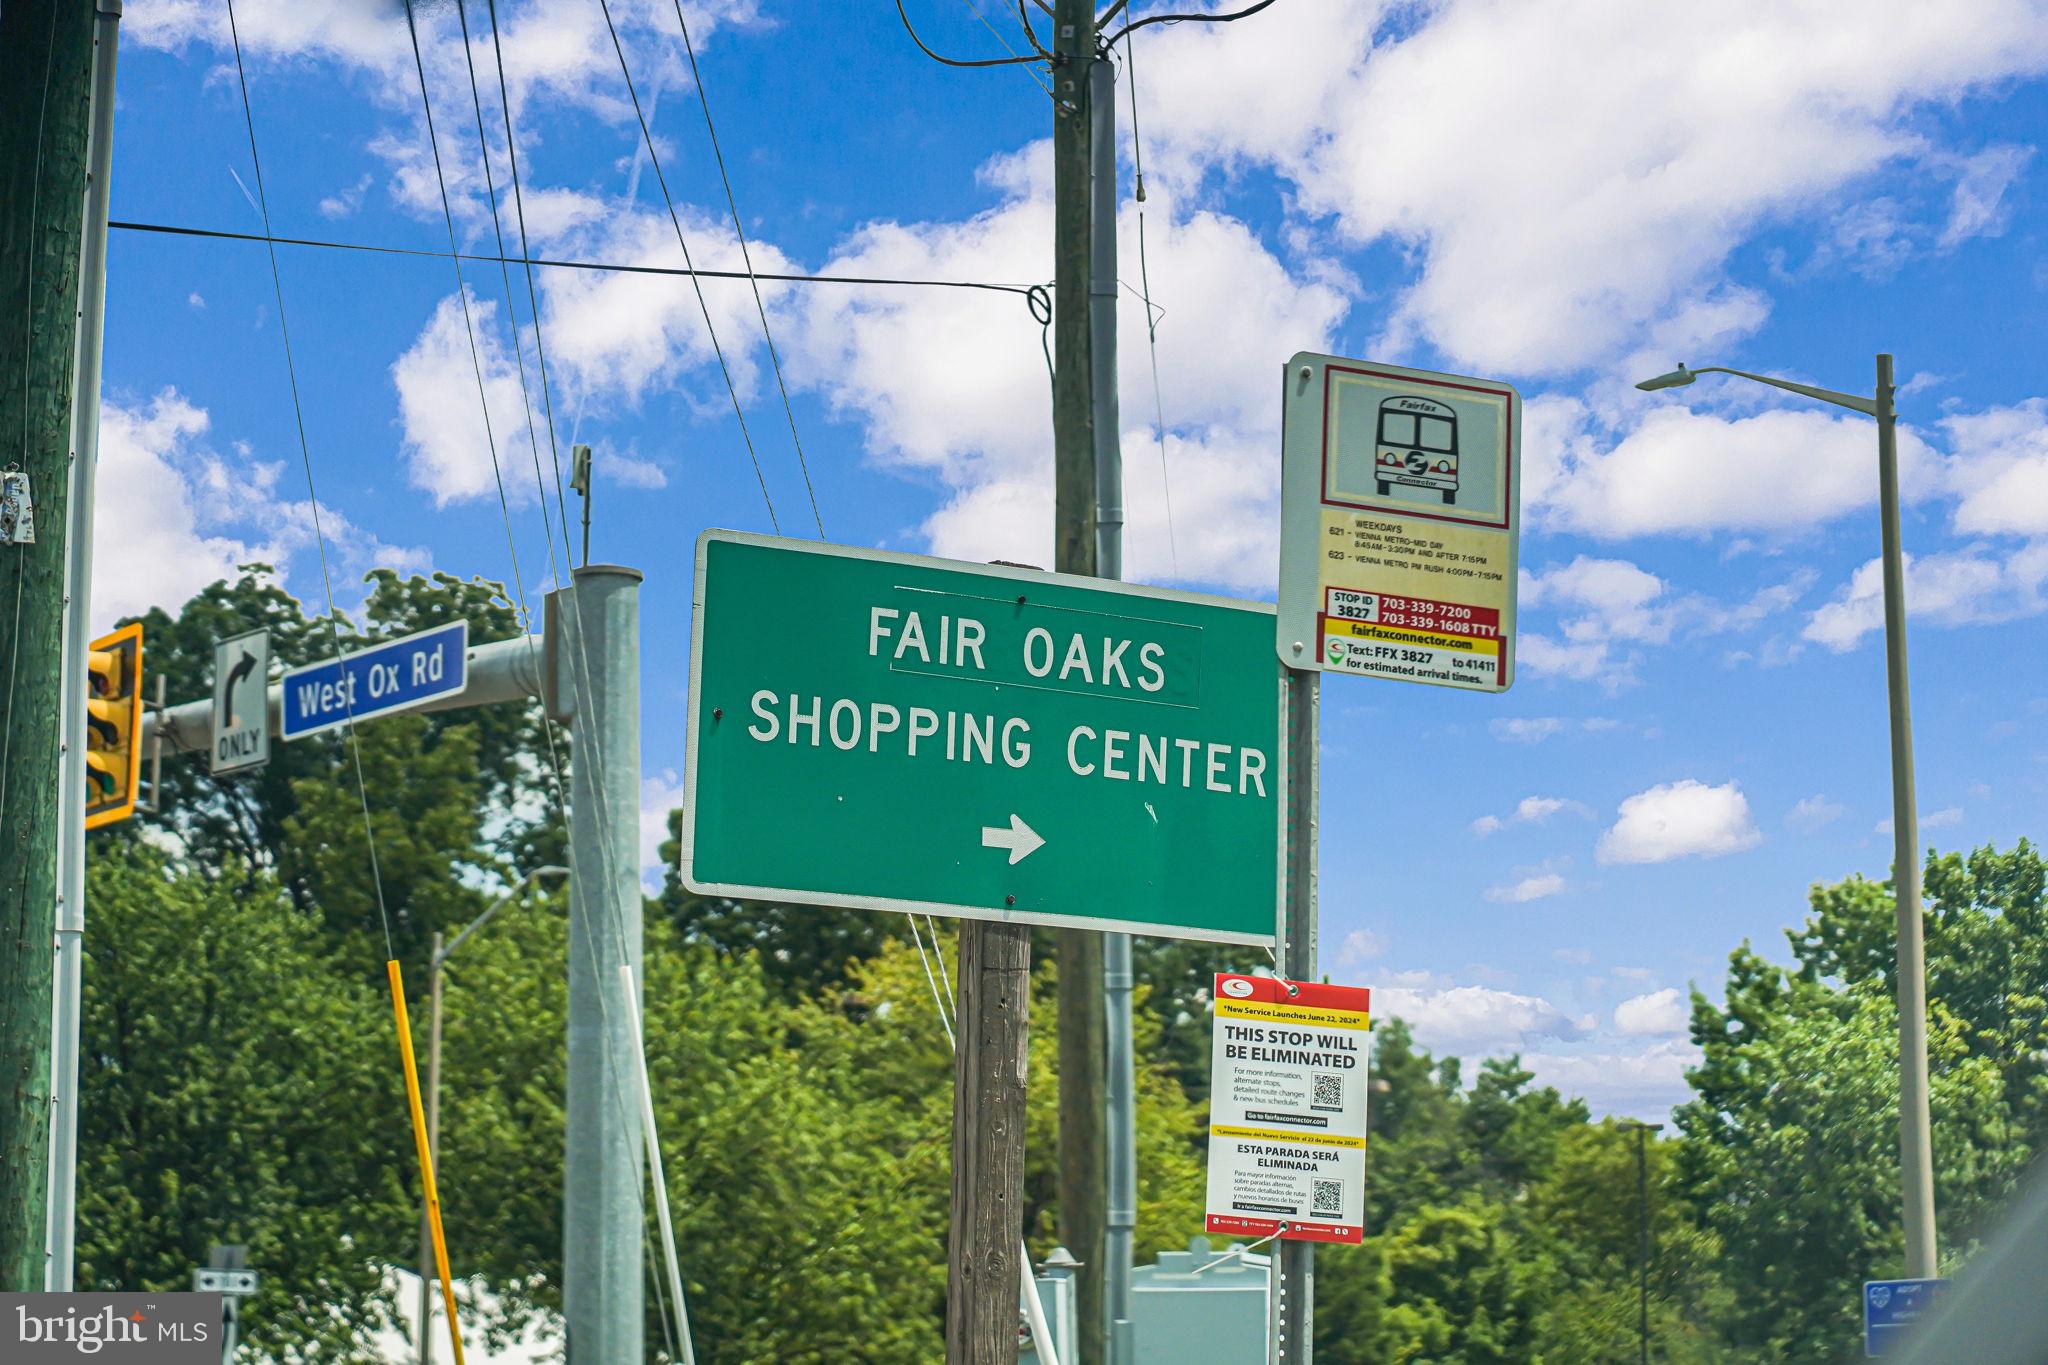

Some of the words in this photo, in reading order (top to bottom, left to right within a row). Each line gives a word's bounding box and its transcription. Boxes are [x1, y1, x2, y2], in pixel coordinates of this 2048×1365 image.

[1400, 400, 1437, 412] Fairfax
[1396, 476, 1437, 486] Connector
[1355, 520, 1402, 533] WEEKDAYS
[1328, 527, 1344, 536] 621
[1355, 531, 1381, 541] VIENNA
[1430, 541, 1444, 549] DAY
[1328, 550, 1344, 560] 623
[1355, 556, 1380, 564] VIENNA
[1384, 559, 1408, 568] METRO
[1424, 564, 1444, 573] RUSH
[1418, 550, 1433, 558] AND
[1436, 552, 1460, 560] AFTER
[1334, 592, 1360, 604] STOP
[1362, 596, 1373, 605] ID
[1338, 605, 1370, 618] 3827
[1382, 598, 1472, 619] 703-339-7200
[1382, 612, 1470, 634] 703-339-1608
[1472, 624, 1496, 636] TTY
[1352, 624, 1472, 650] fairfaxconnector.com
[869, 606, 986, 670] FAIR
[1023, 627, 1165, 692] OAKS
[1346, 644, 1373, 656] Text:
[1375, 646, 1398, 660] FFX
[1401, 650, 1433, 664] 3827
[1452, 658, 1464, 668] to
[1466, 660, 1495, 672] 41411
[1346, 658, 1361, 668] for
[1364, 660, 1414, 676] estimated
[1417, 668, 1450, 680] arrival
[1452, 672, 1483, 684] times.
[298, 671, 357, 718] West
[368, 663, 400, 698] Ox
[412, 643, 444, 686] Rd
[219, 728, 260, 761] ONLY
[748, 689, 1031, 768] SHOPPING
[1067, 725, 1266, 798] CENTER
[1244, 1007, 1271, 1016] Service
[1272, 1010, 1306, 1020] Launches
[1308, 1014, 1324, 1022] June
[1225, 1026, 1264, 1042] THIS
[1268, 1030, 1312, 1047] STOP
[1317, 1035, 1357, 1050] WILL
[1226, 1044, 1246, 1060] BE
[1252, 1047, 1356, 1068] ELIMINATED
[1234, 1076, 1262, 1085] alternate
[1265, 1070, 1302, 1080] information,
[1234, 1086, 1260, 1094] detailed
[1268, 1098, 1298, 1106] schedules
[1265, 1114, 1326, 1126] fairfaxconnector.com
[1238, 1144, 1263, 1155] ESTA
[1266, 1147, 1310, 1159] PARADA
[1312, 1151, 1340, 1162] SERÁ
[1258, 1158, 1318, 1172] ELIMINADA
[1265, 1172, 1296, 1180] información
